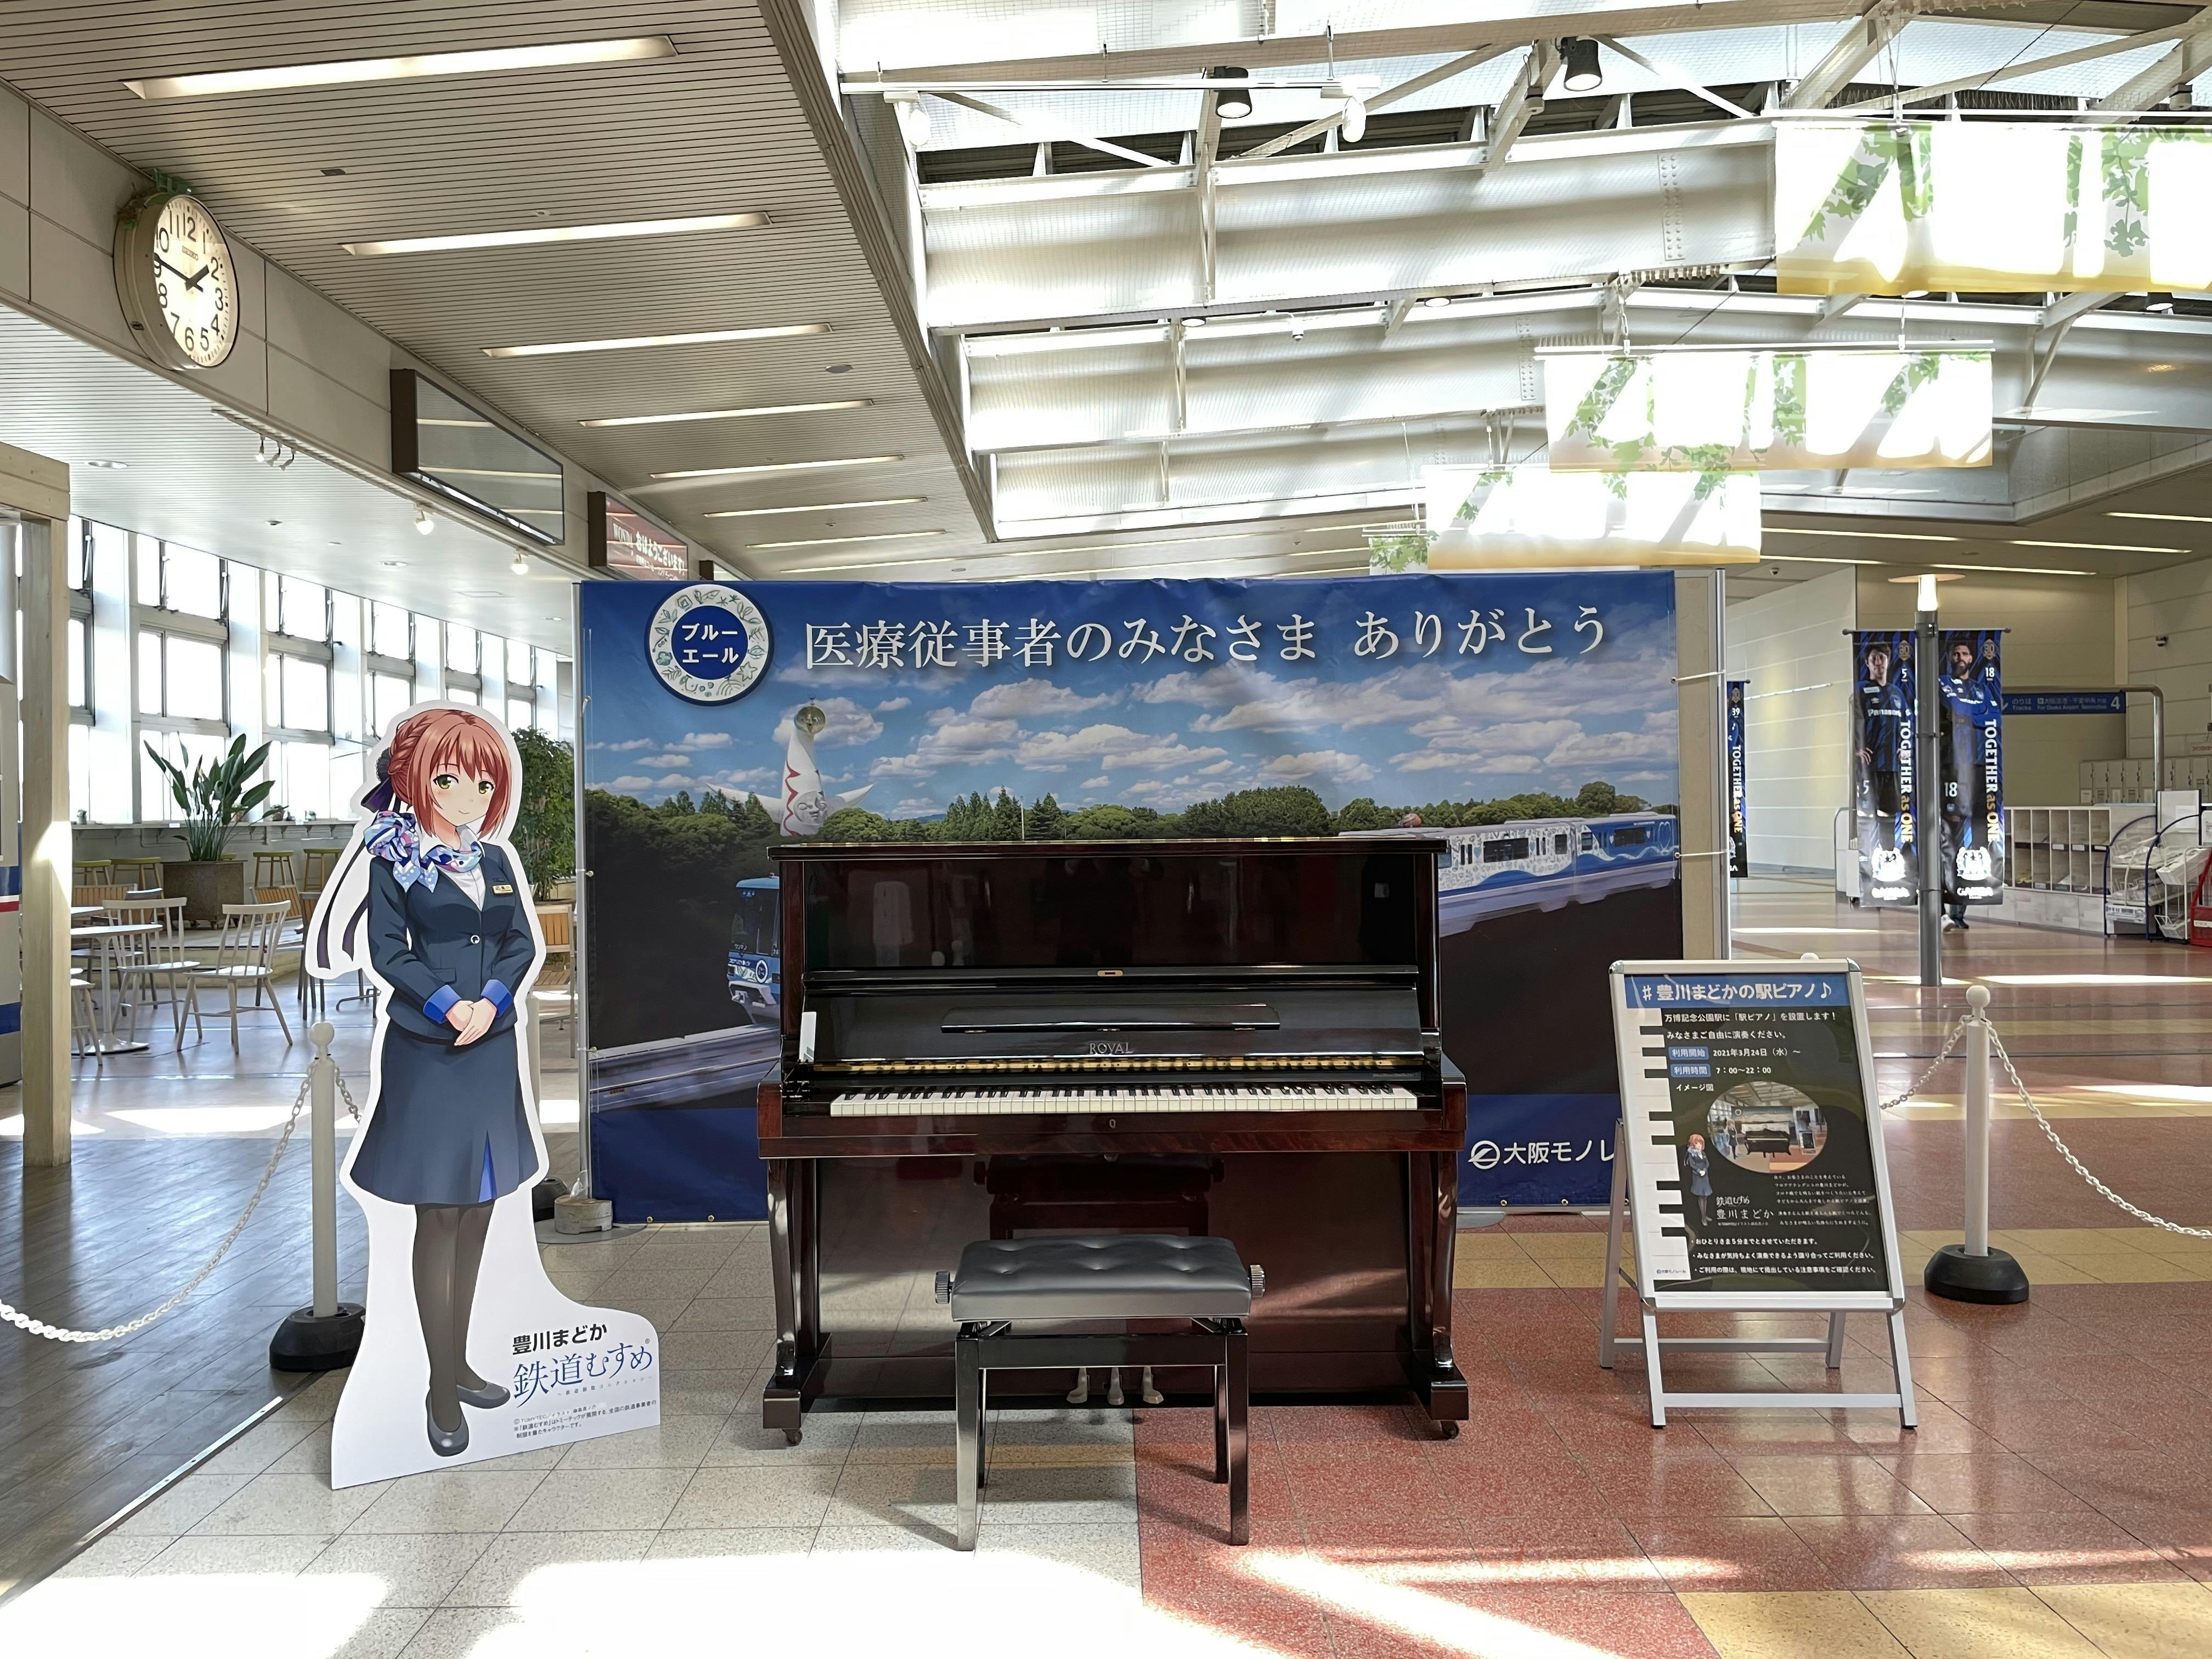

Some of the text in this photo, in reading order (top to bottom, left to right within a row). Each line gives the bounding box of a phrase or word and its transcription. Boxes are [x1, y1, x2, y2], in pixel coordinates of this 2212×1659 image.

[170, 211, 179, 238] 11
[183, 212, 196, 242] 12
[156, 224, 170, 253] 10
[211, 256, 219, 281] 2
[159, 283, 167, 308] 8
[215, 287, 223, 311] 3
[170, 312, 180, 338] 7
[211, 313, 220, 336] 4
[185, 327, 194, 351] 6
[200, 327, 209, 351] 5
[682, 623, 738, 641] ブルー
[805, 606, 1604, 669] 医療従事者のみなさま ありがとう
[682, 647, 739, 663] エール
[1901, 668, 1907, 679] 5
[1985, 667, 1995, 678] 18
[1732, 708, 1740, 716] 39
[2111, 696, 2120, 710] 4
[1863, 780, 1870, 794] 5
[1900, 720, 1913, 843] TOGETHER as ONE
[1944, 782, 1957, 797] 18
[1984, 719, 2000, 843] TOGETHER as ONE
[1090, 1042, 1135, 1054] ROYAL
[1672, 1048, 1706, 1057] 利用開始
[1674, 1066, 1707, 1075] 利用時間
[1717, 1209, 1774, 1219] 豊川まどか
[512, 1323, 607, 1355] 豊川まどか
[514, 1342, 652, 1408] 鉄道むすめ
